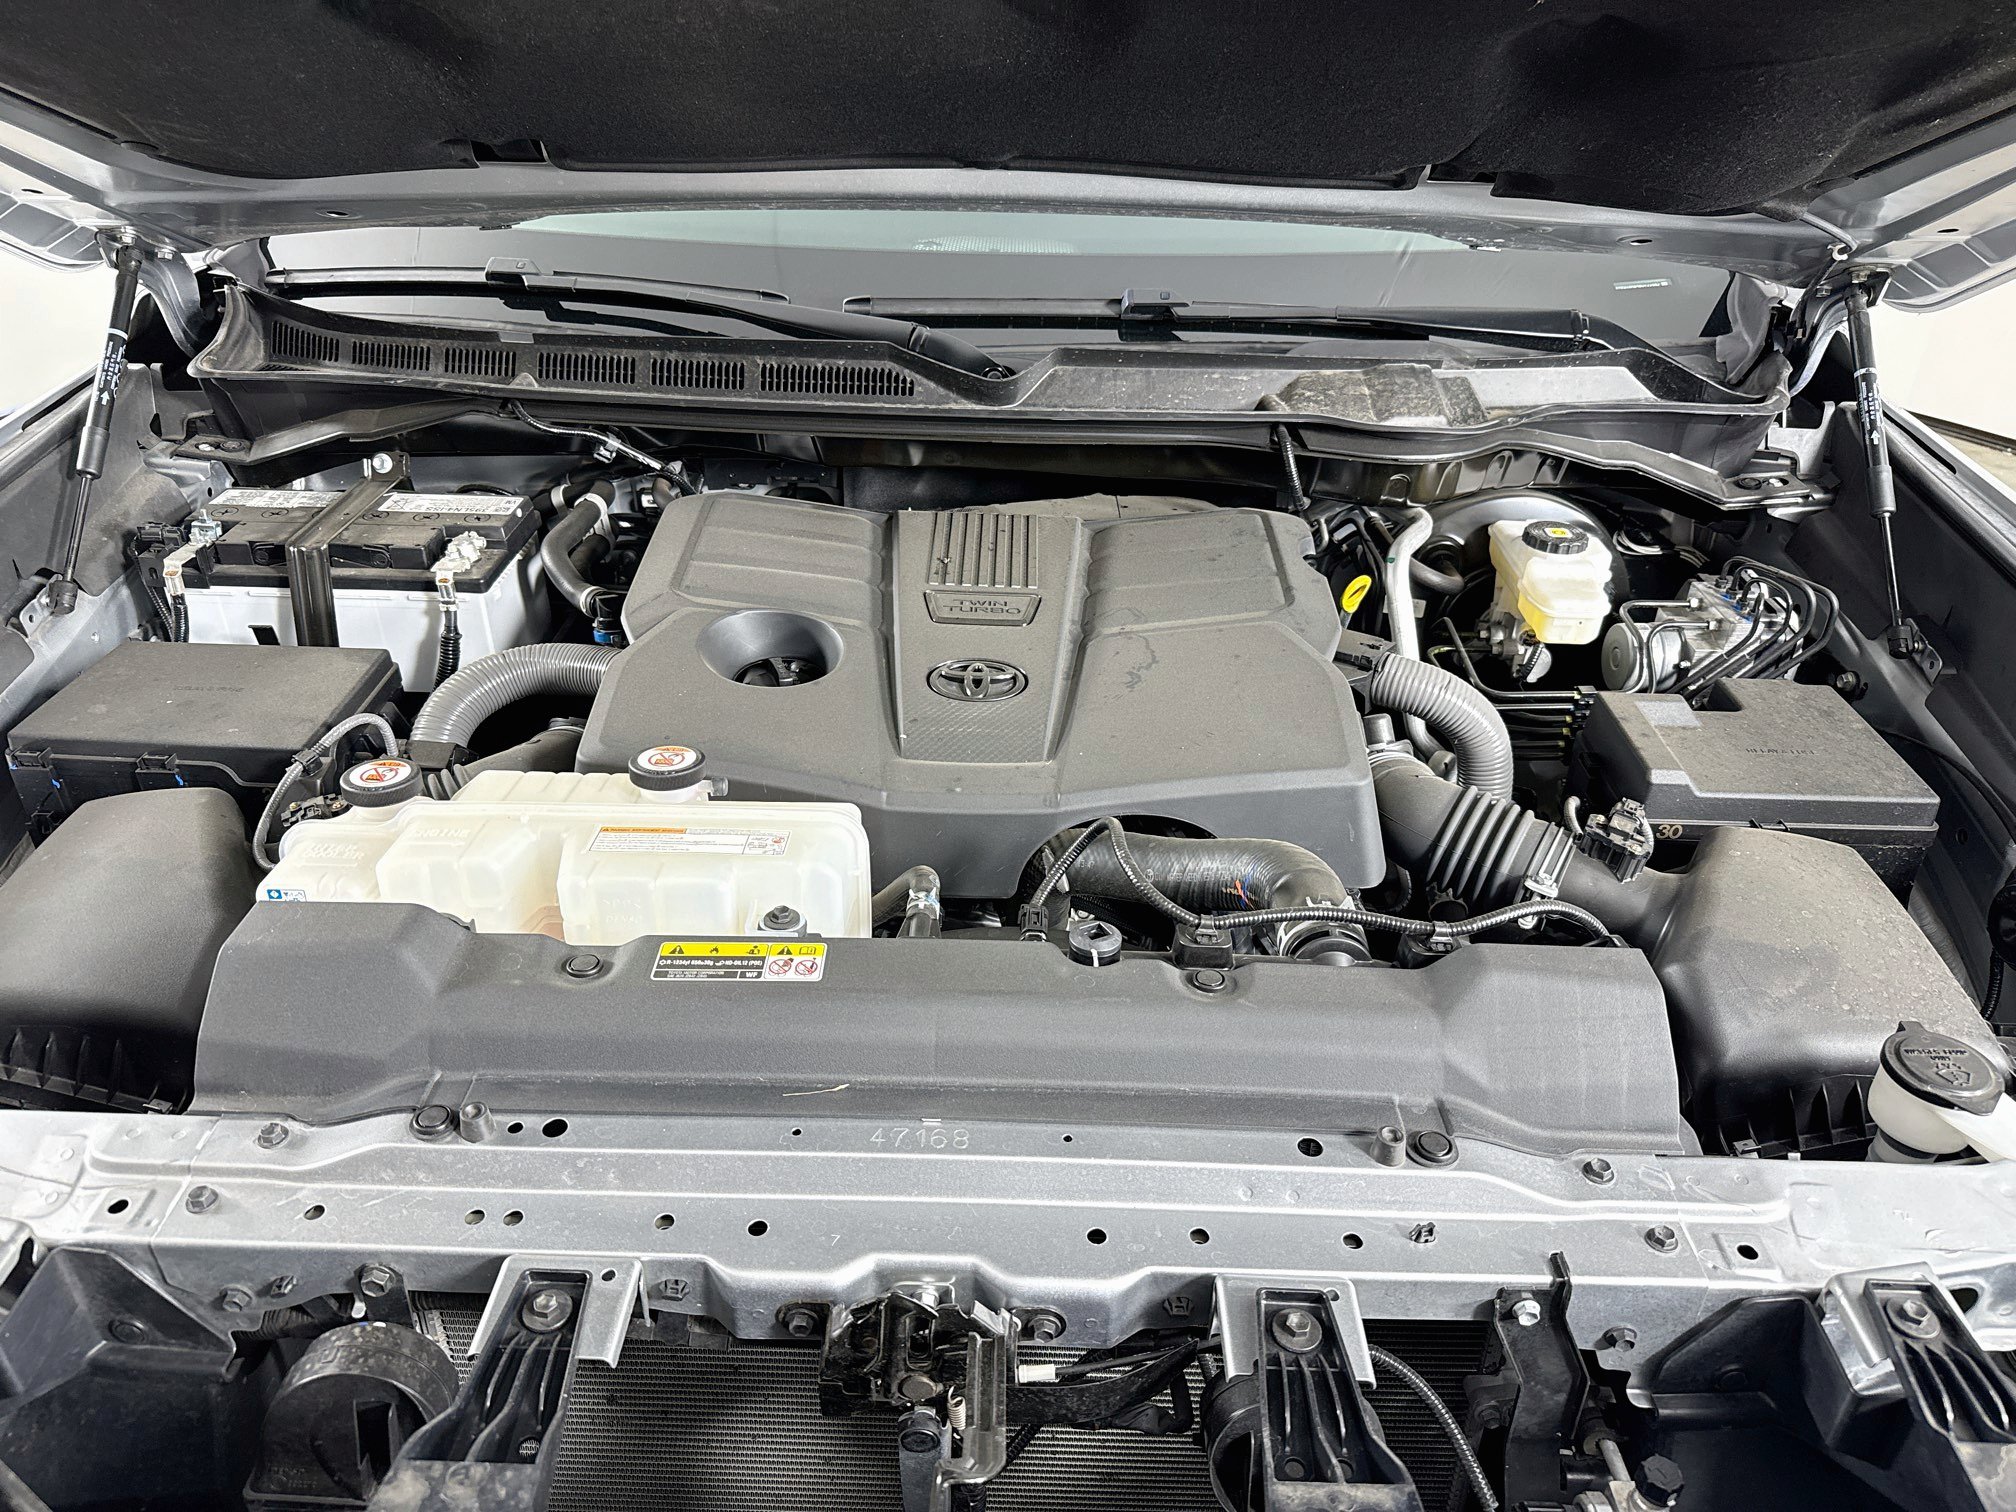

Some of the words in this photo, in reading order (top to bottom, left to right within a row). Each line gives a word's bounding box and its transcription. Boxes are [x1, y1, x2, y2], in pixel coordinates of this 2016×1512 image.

[952, 599, 1008, 607] TWIN
[943, 605, 1021, 614] TURBO
[1655, 824, 1683, 839] 30
[869, 1127, 970, 1149] 47168
